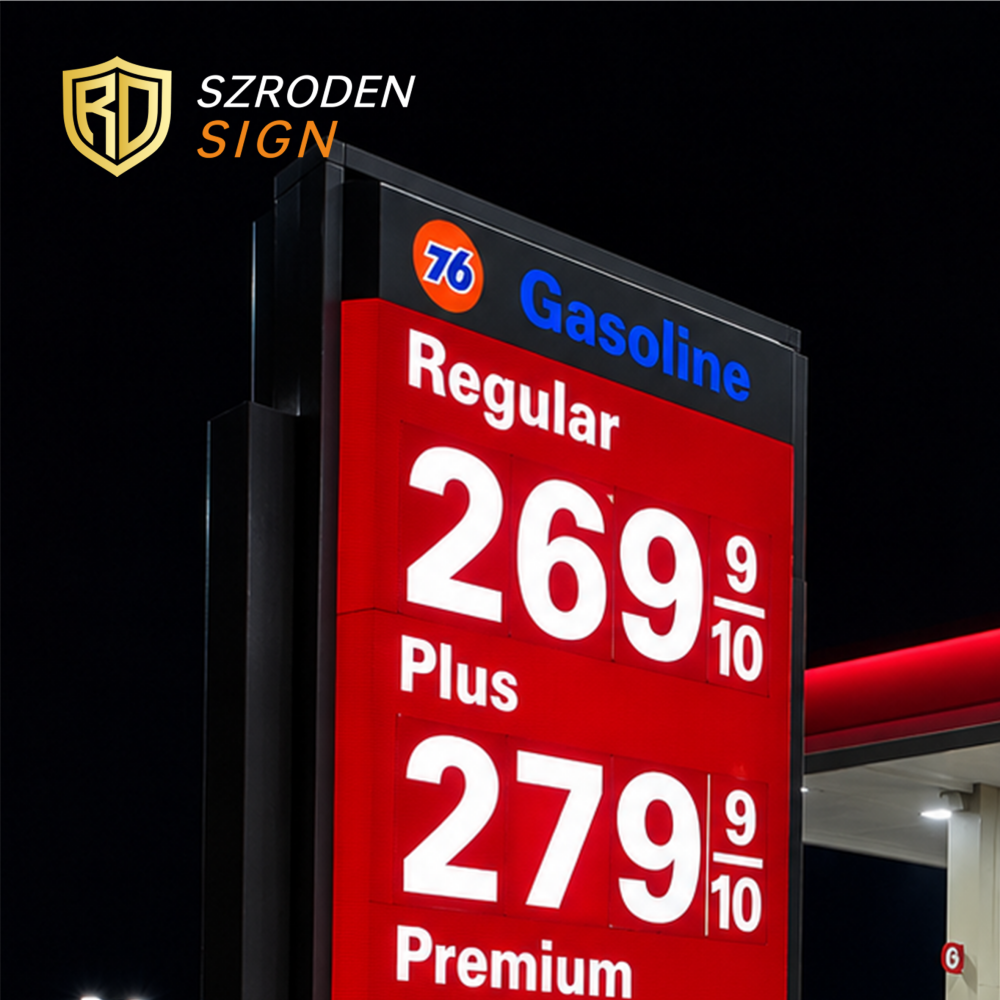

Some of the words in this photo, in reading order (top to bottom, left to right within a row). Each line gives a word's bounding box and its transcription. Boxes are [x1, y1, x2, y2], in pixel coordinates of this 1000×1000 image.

[423, 240, 475, 294] 76
[520, 269, 751, 402] Gasoline
[408, 329, 620, 451] Regular
[406, 447, 704, 662] 269
[725, 536, 758, 593] 9
[400, 635, 519, 712] Plus
[711, 620, 764, 681] 10
[403, 735, 701, 923] 279
[725, 790, 757, 846] 9
[710, 875, 762, 932] 10
[396, 925, 632, 998] Premium
